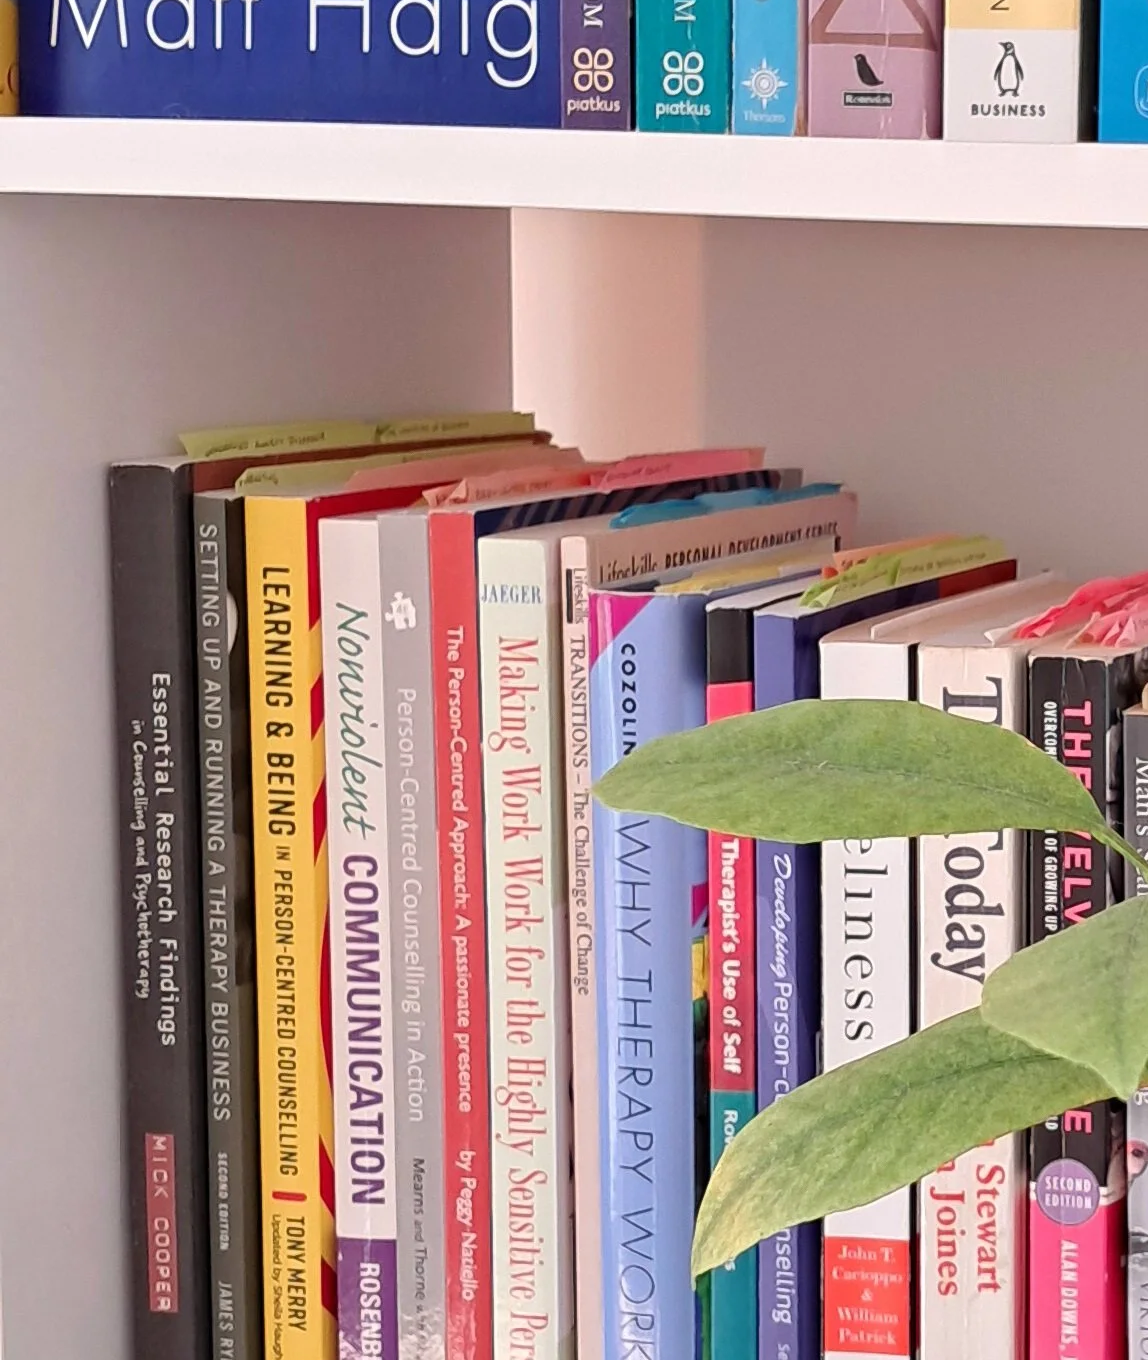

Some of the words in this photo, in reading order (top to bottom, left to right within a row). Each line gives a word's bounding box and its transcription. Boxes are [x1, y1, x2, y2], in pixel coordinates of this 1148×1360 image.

[970, 103, 1046, 118] BUSINESS
[199, 523, 220, 628] SETTING
[201, 638, 222, 671] UP
[261, 566, 293, 709] LEARNING
[445, 625, 466, 663] The
[151, 672, 175, 795] Essential
[202, 678, 223, 730] AND
[265, 720, 293, 738] &
[335, 602, 384, 841] Nonviolent
[447, 667, 469, 812] Person-Centred
[487, 635, 541, 755] Making
[569, 634, 589, 769] TRANSITIONS
[204, 739, 227, 852] RUNNING
[265, 751, 296, 836] BEING
[500, 763, 543, 841] Work
[571, 790, 591, 821] The
[154, 812, 178, 923] Research
[206, 859, 227, 876] A
[274, 845, 291, 862] IN
[448, 815, 471, 910] Approach:
[503, 855, 546, 934] Work
[570, 824, 592, 909] Challenge
[614, 818, 652, 947] WHY
[207, 885, 229, 993] THERAPY
[273, 868, 298, 1040] PERSON-CENTRED
[454, 914, 472, 931] A
[504, 945, 546, 992] for
[573, 933, 594, 997] Change
[575, 911, 594, 931] of
[156, 938, 181, 1047] Findings
[342, 853, 386, 1205] COMMUNICATION
[450, 935, 474, 1028] passionate
[505, 998, 547, 1046] the
[209, 1001, 232, 1122] BUSINESS
[454, 1032, 473, 1113] presence
[495, 1056, 550, 1157] Highly
[616, 969, 654, 1185] THERAPY
[276, 1046, 299, 1176] COUNSELLING
[508, 1166, 550, 1301] Sensitive
[929, 1186, 966, 1297] Joines
[974, 1162, 1006, 1294] Stewart
[1059, 1239, 1079, 1283] ALAN
[1058, 1287, 1079, 1350] DOWNS,
